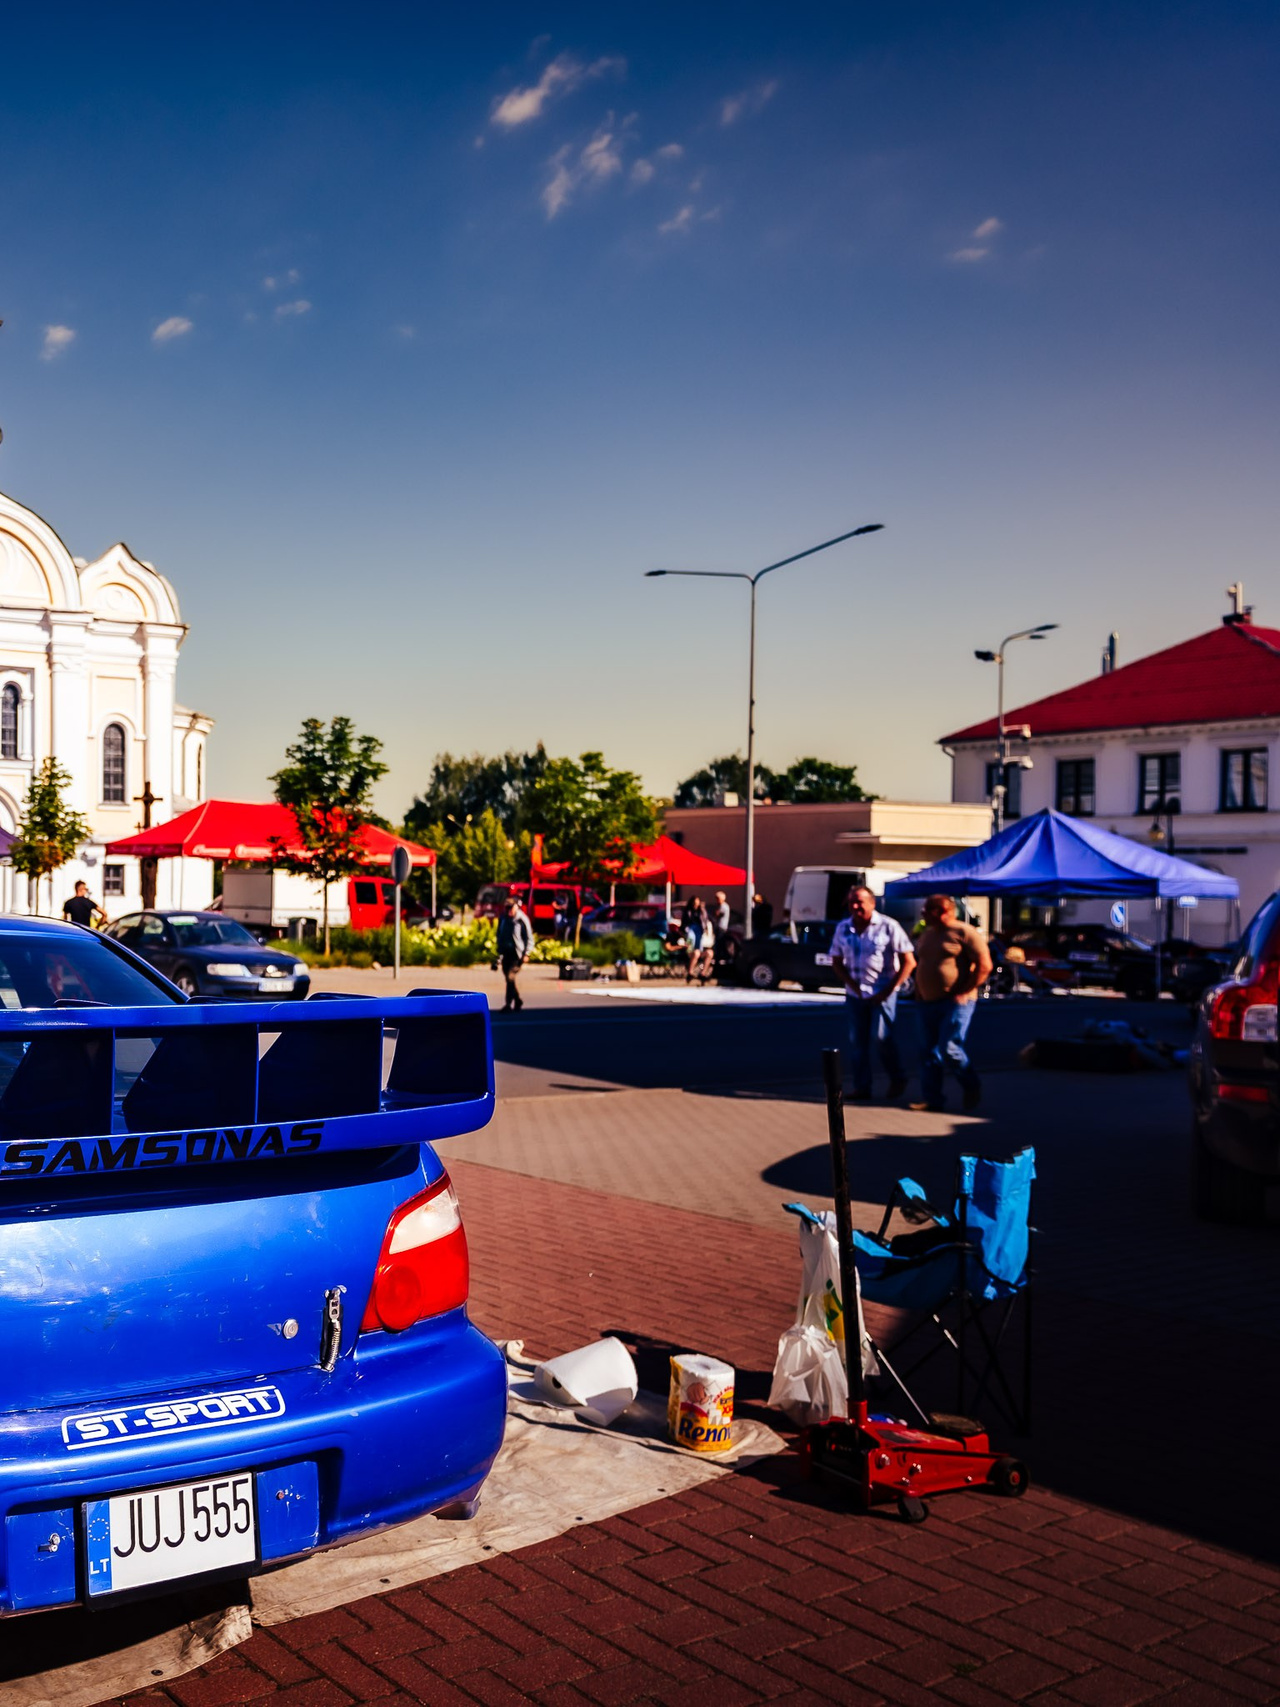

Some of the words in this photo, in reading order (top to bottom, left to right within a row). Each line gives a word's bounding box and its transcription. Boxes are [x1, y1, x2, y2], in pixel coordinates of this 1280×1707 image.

[0, 1121, 325, 1176] SAMSONAS
[75, 1390, 273, 1440] ST-SPORT
[89, 1558, 110, 1575] LT
